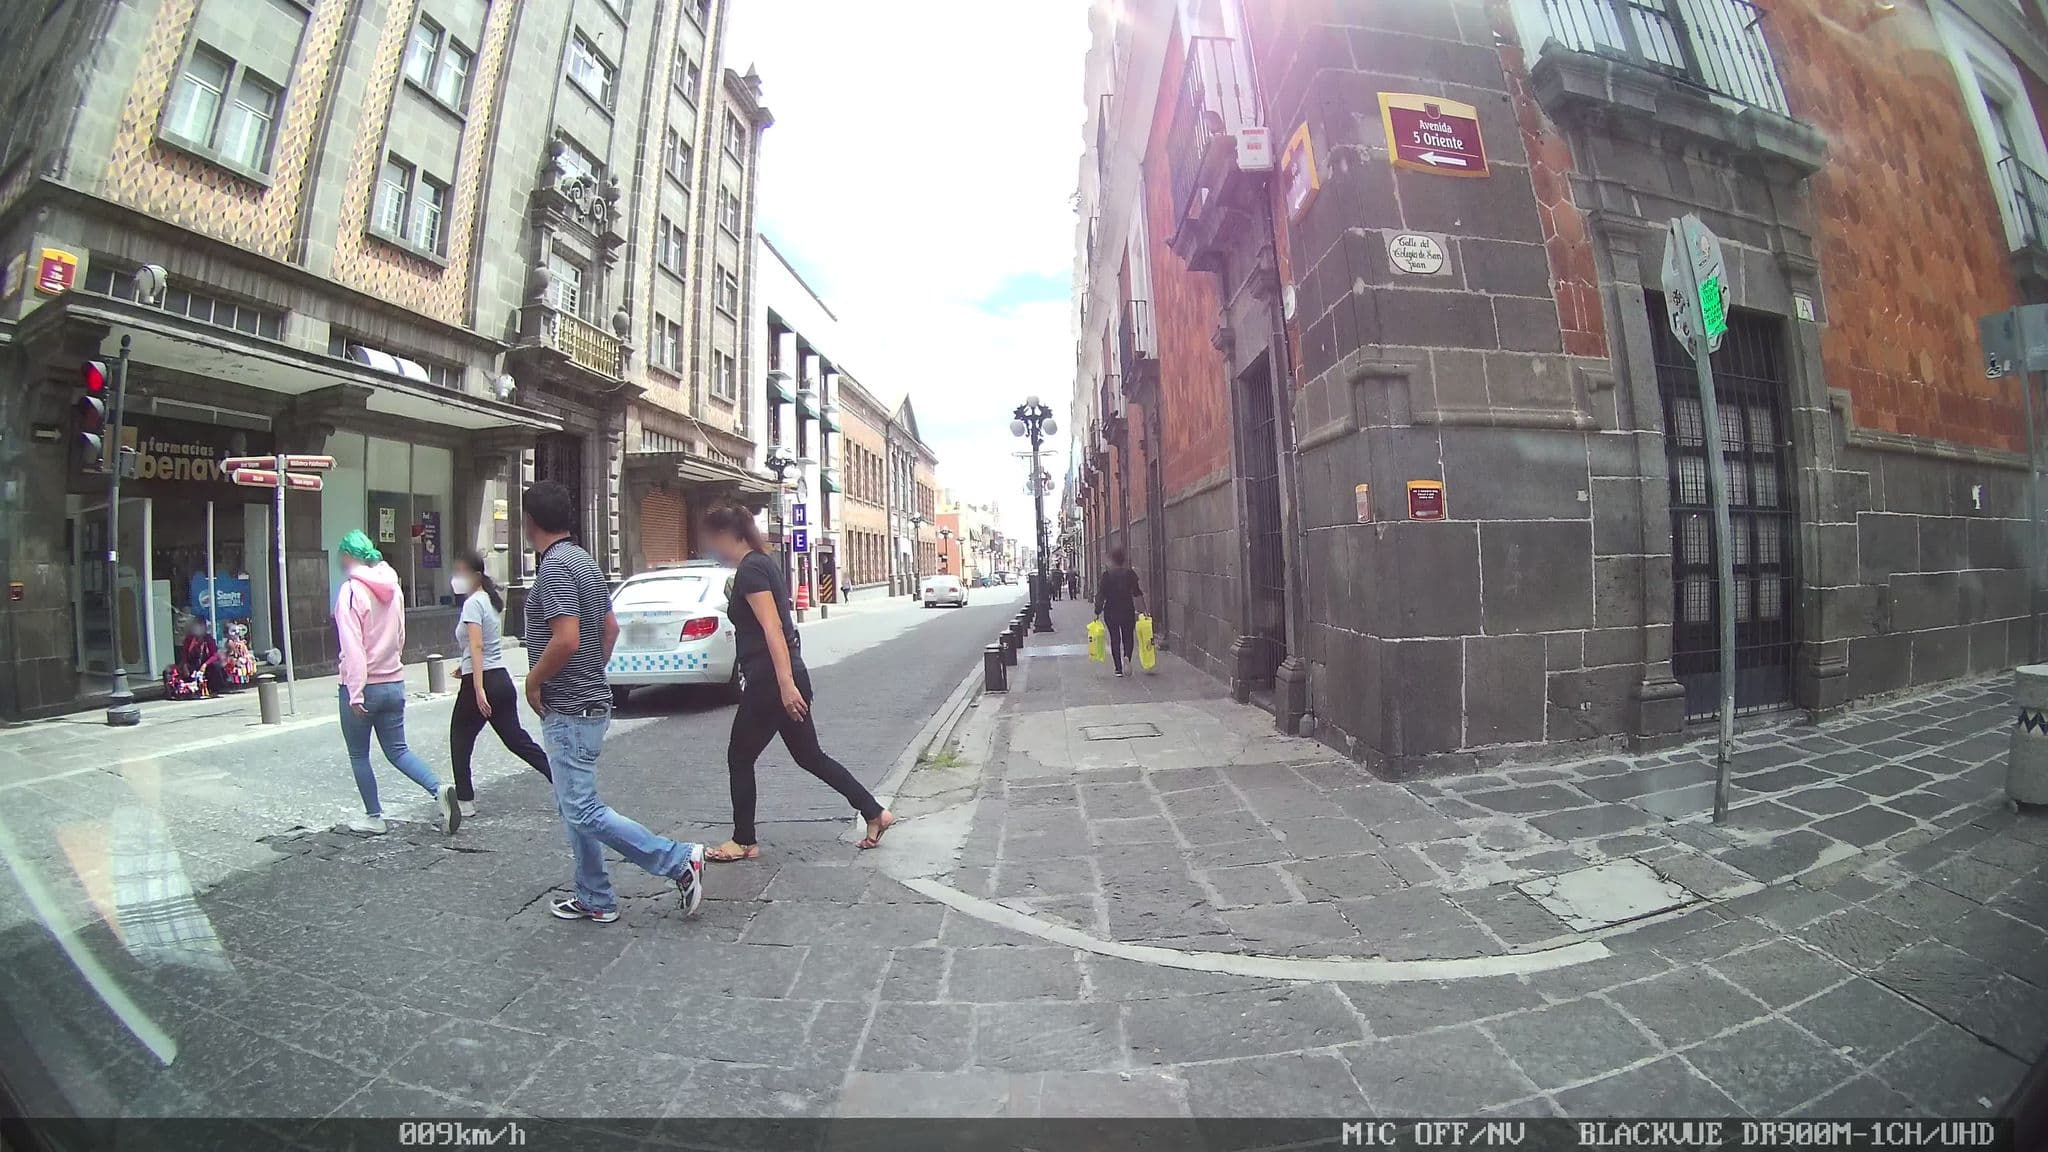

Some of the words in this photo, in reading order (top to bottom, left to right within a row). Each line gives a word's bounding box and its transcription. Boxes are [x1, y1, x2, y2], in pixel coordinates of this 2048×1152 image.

[1419, 119, 1453, 134] Avenida
[1413, 131, 1421, 144] 5
[1423, 132, 1465, 150] Oriente
[149, 436, 214, 457] farmacias
[138, 441, 230, 482] benav
[795, 509, 804, 522] H
[796, 534, 804, 548] E
